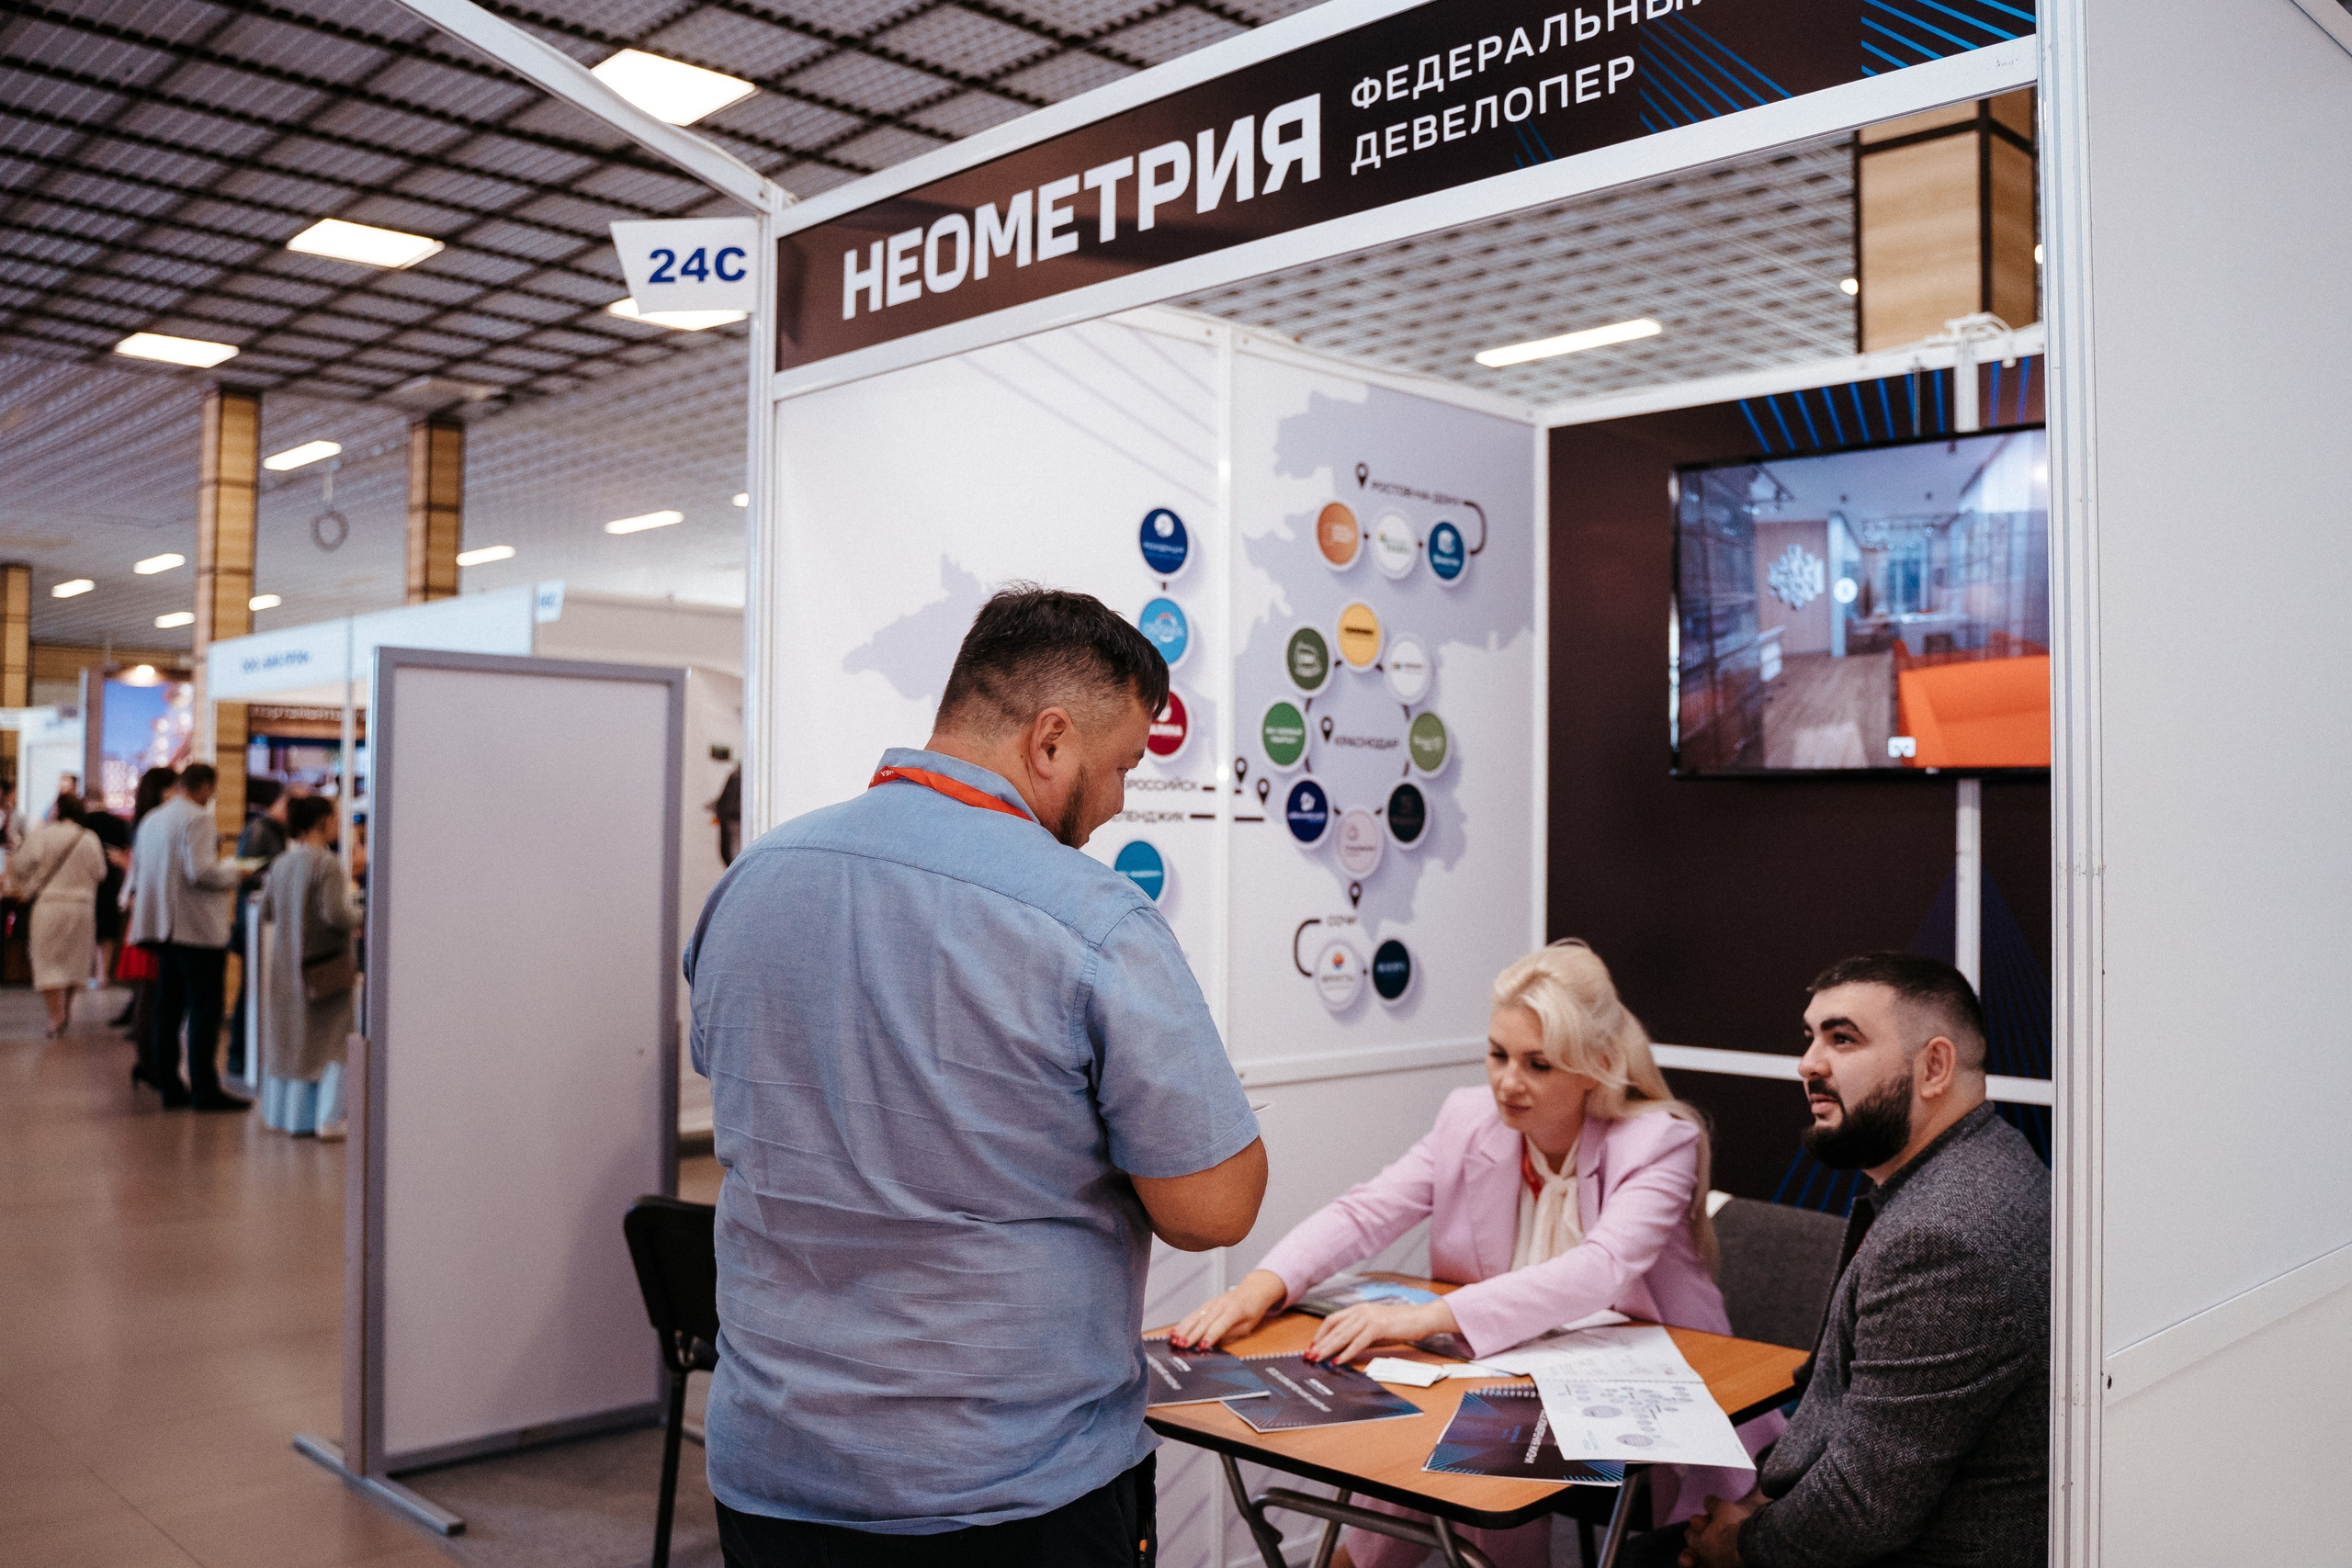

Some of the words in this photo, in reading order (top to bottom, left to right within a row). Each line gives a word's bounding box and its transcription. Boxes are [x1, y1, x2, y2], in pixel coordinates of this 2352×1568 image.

[1351, 0, 1702, 109] ФЕДЕРАЛЬНЫ
[1351, 55, 1635, 176] ДЕВЕЛОПЕР
[841, 93, 1321, 321] НЕОМЕТРИЯ
[1125, 775, 1197, 792] РОССИЙСК
[1334, 734, 1399, 750] КРАСНОДАР
